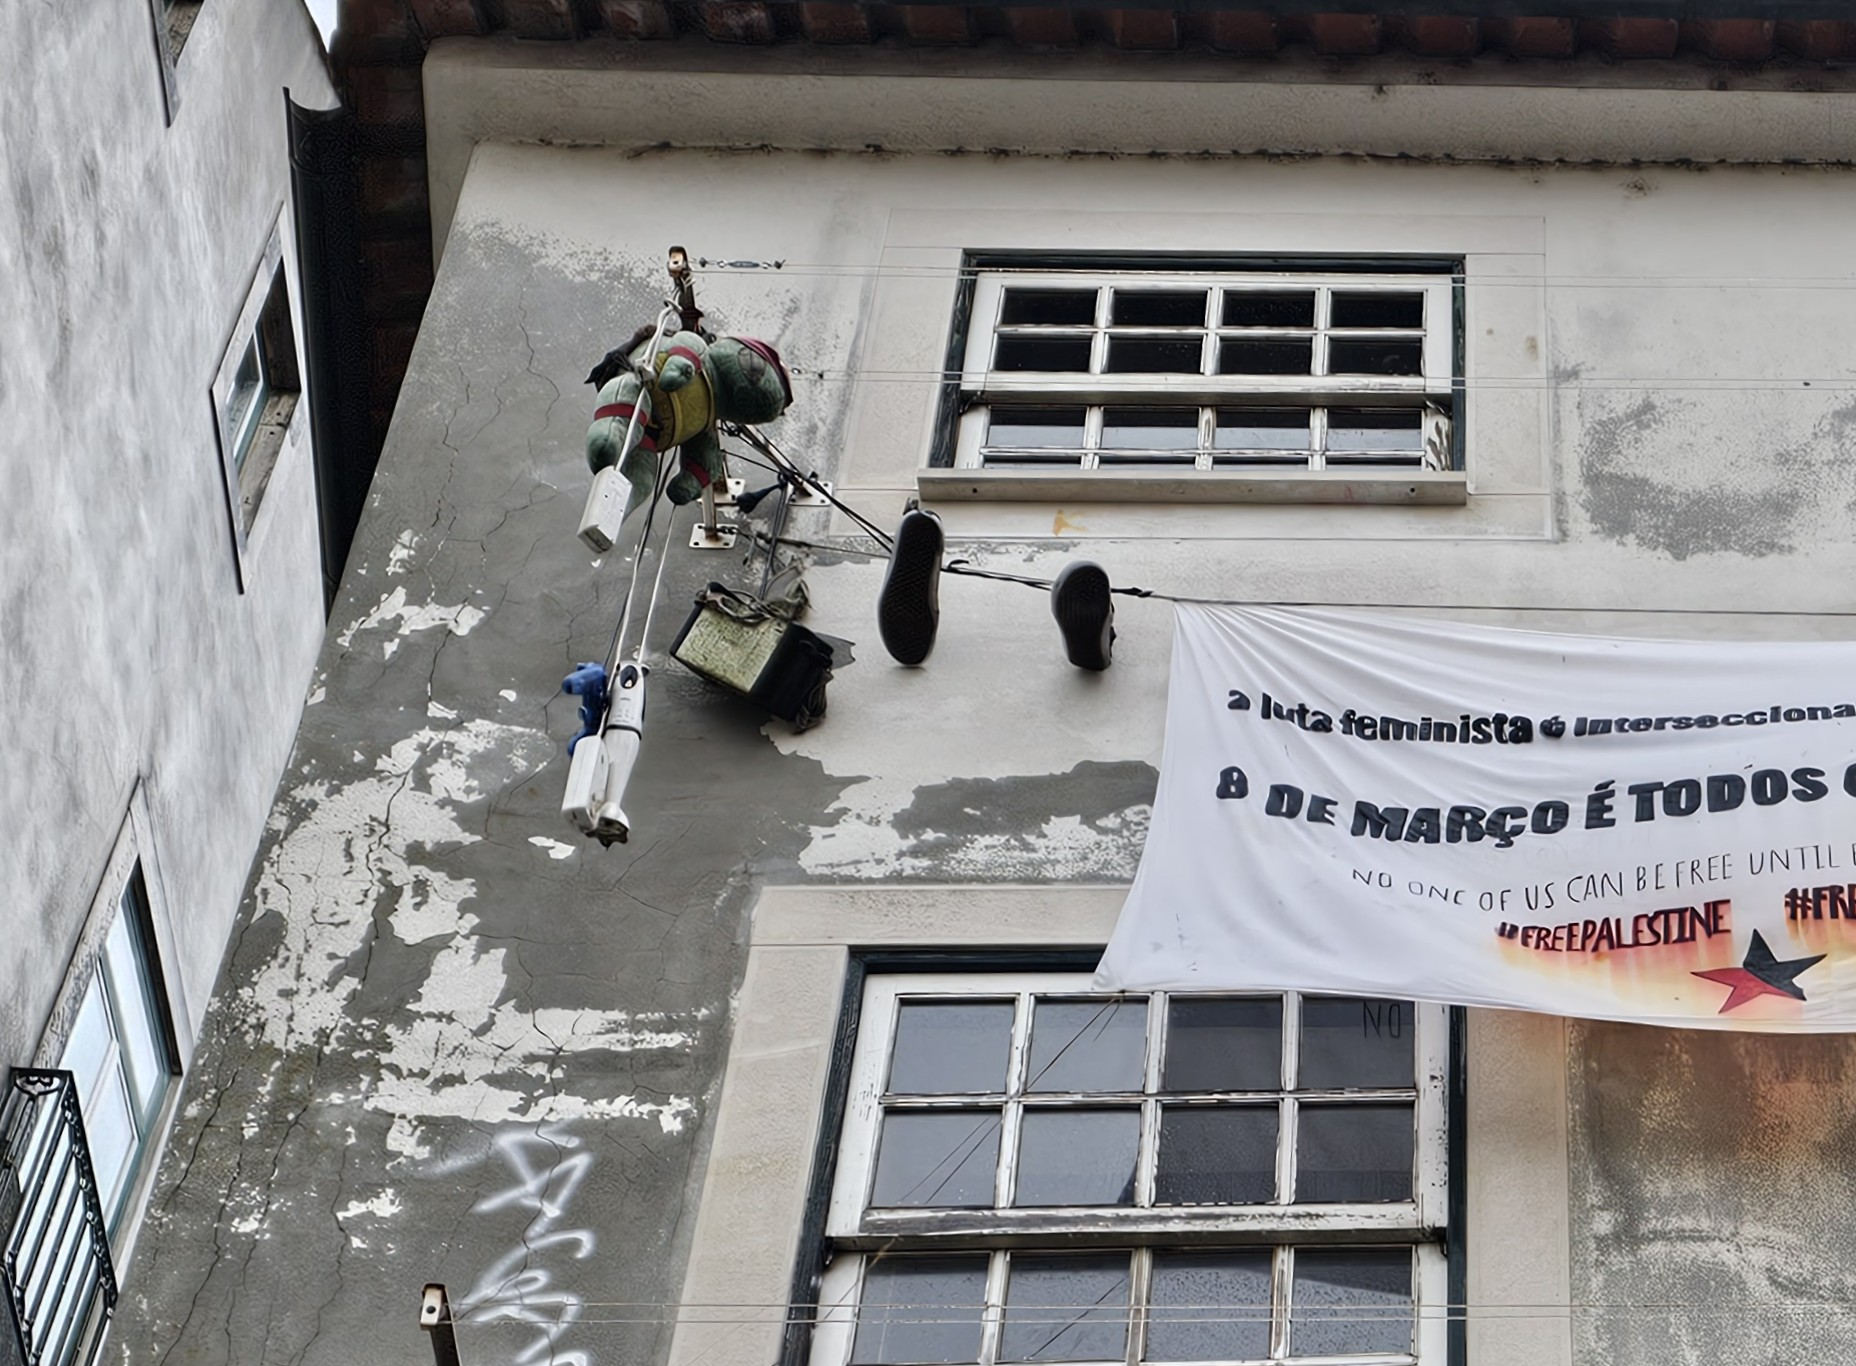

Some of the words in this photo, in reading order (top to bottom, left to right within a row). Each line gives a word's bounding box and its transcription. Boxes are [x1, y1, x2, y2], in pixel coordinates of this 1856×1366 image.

[1227, 690, 1251, 710] a
[1261, 692, 1333, 734] luta
[1339, 708, 1534, 745] feminista
[1539, 715, 1566, 739] é
[1216, 766, 1249, 800] 8
[1265, 784, 1338, 827] DE
[1350, 800, 1569, 848] MARÇO
[1585, 780, 1616, 830] É
[1627, 767, 1829, 822] TODOS
[1352, 867, 1392, 889] NO
[1408, 880, 1465, 905] ONE
[1479, 889, 1512, 911] OF
[1524, 881, 1555, 911] US
[1566, 871, 1624, 903] CAN
[1675, 853, 1733, 886] FREE
[1749, 844, 1840, 876] UNTIL
